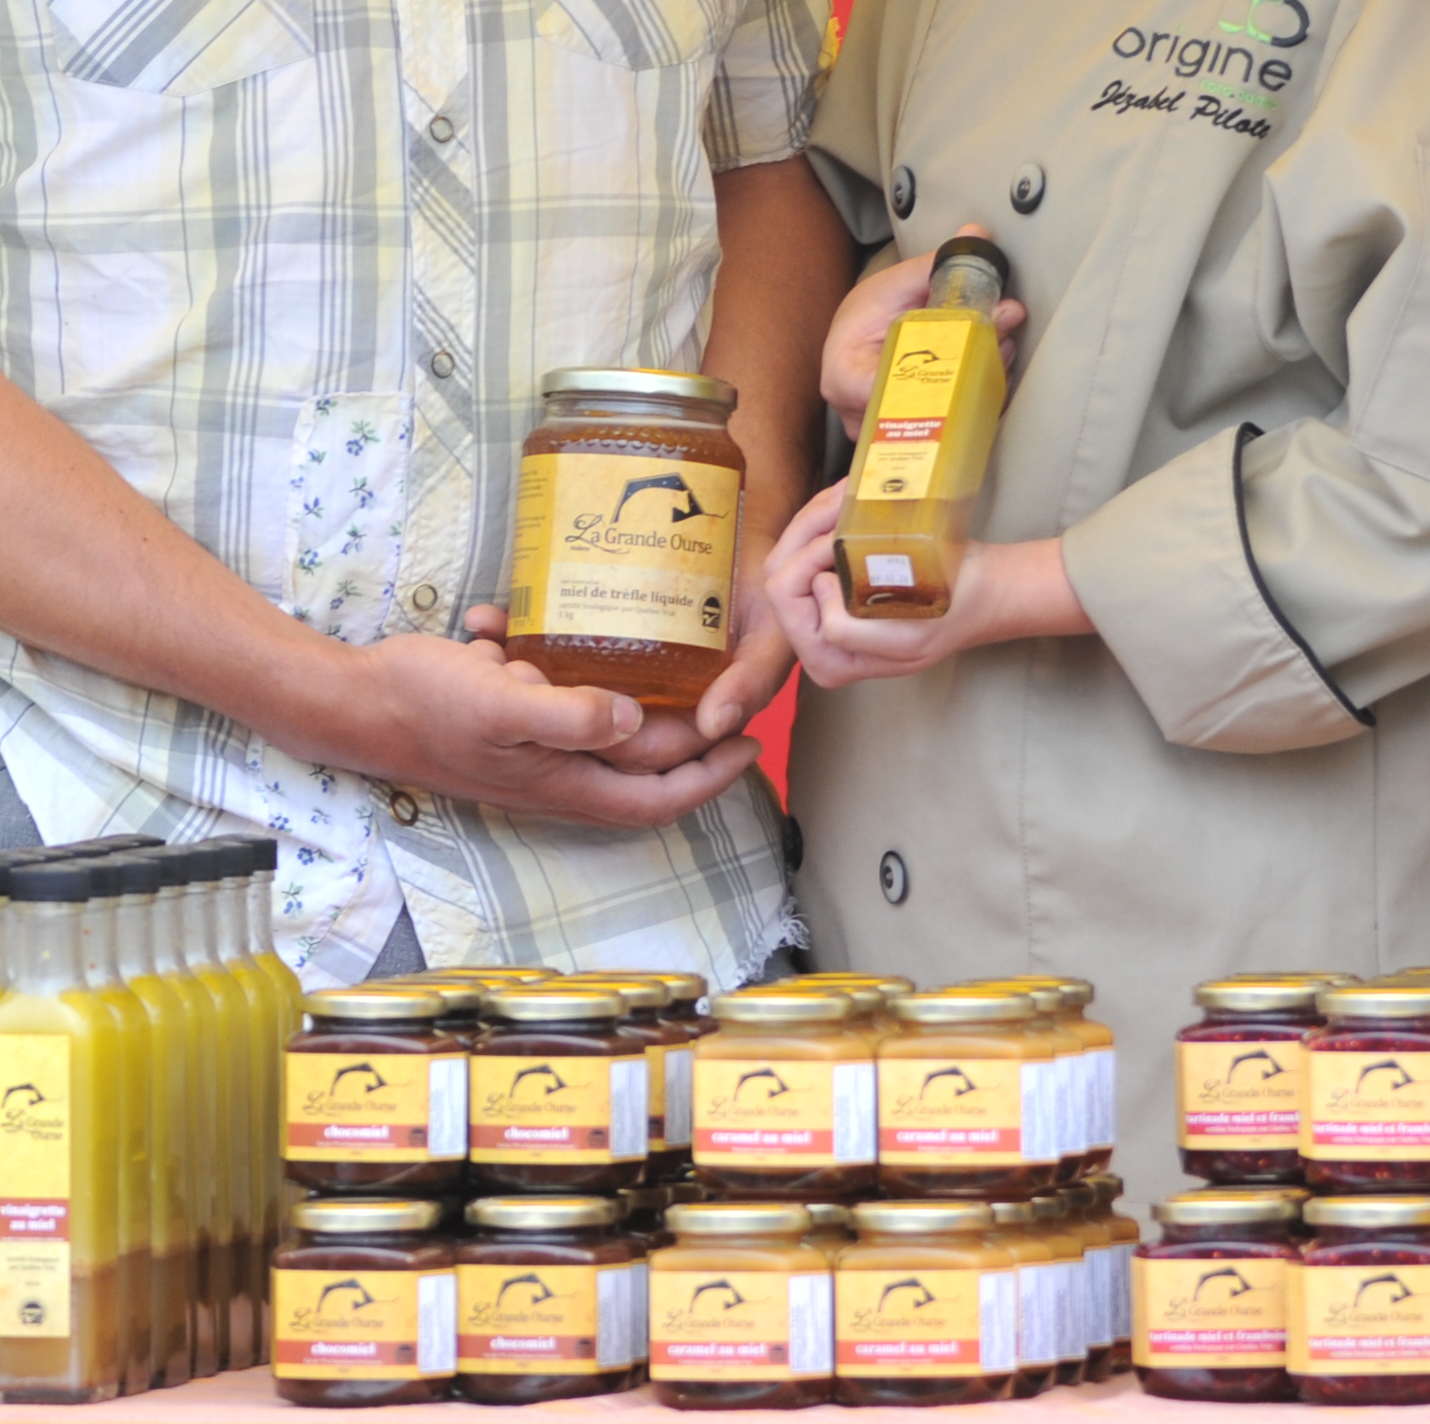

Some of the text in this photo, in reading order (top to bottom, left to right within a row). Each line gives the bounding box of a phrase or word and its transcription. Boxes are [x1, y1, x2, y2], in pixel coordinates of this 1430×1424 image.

[1112, 26, 1293, 92] origine
[878, 420, 942, 431] vinaigrette
[564, 513, 713, 554] La Grande Ourse
[560, 586, 694, 607] miel de trèfle liquide
[324, 1124, 390, 1139] chocomiel
[504, 1126, 569, 1140] chocomiel
[711, 1130, 760, 1144] caramel
[781, 1130, 810, 1145] miel
[896, 1130, 947, 1143] caramel
[969, 1130, 998, 1143] miel
[0, 1203, 66, 1218] vinaigrette
[28, 1218, 56, 1230] miel
[311, 1342, 377, 1356] chocomiel
[490, 1336, 556, 1350] chocomiel
[667, 1342, 716, 1356] caramel
[736, 1342, 767, 1356] miel
[855, 1342, 906, 1356] caramel
[929, 1342, 957, 1355] miel
